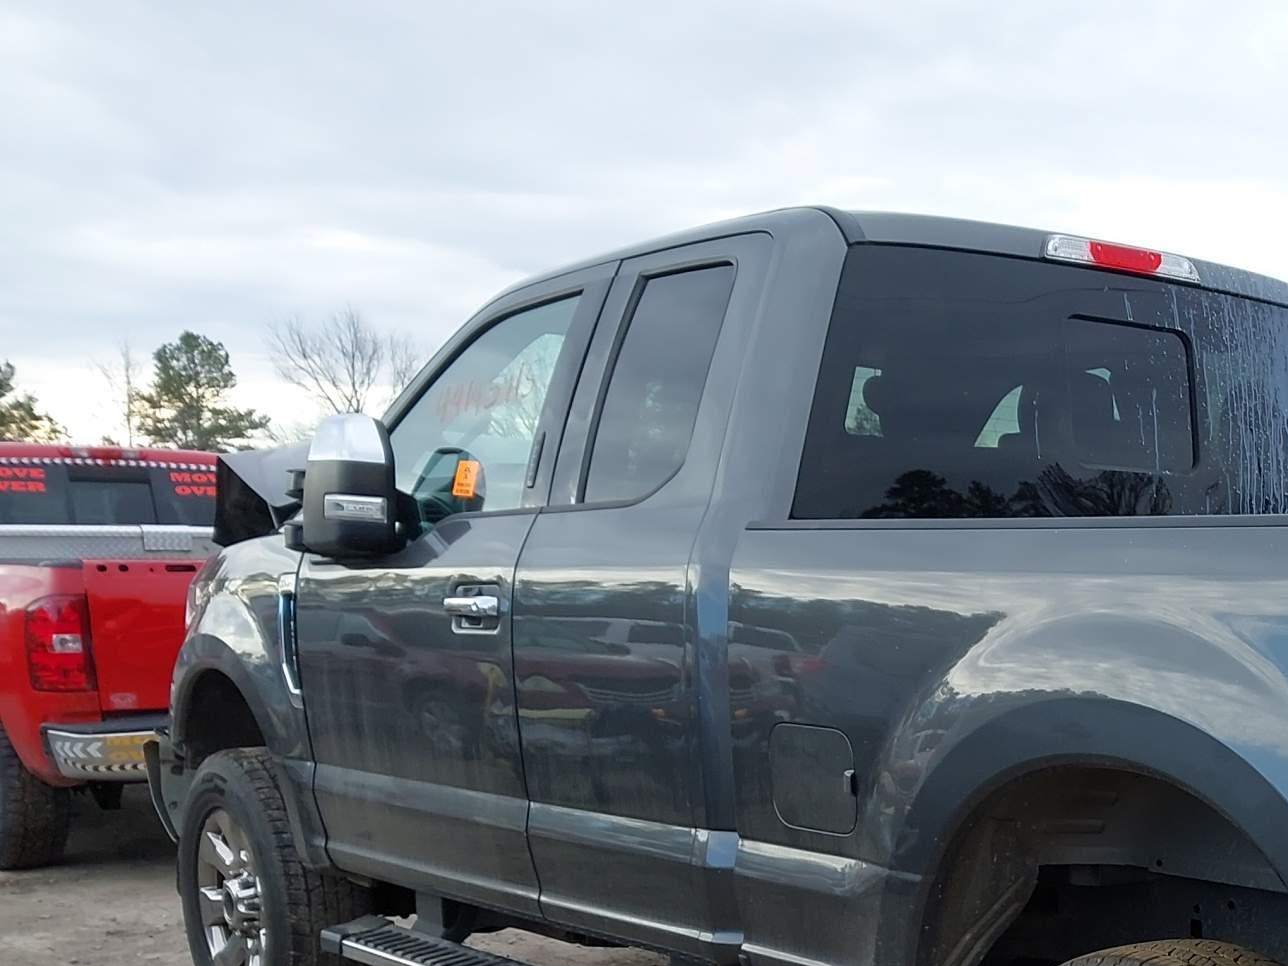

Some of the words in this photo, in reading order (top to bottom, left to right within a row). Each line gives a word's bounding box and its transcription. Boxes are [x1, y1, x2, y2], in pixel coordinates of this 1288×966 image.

[0, 467, 45, 479] OVE
[169, 472, 217, 484] MOV
[0, 481, 46, 493] VER
